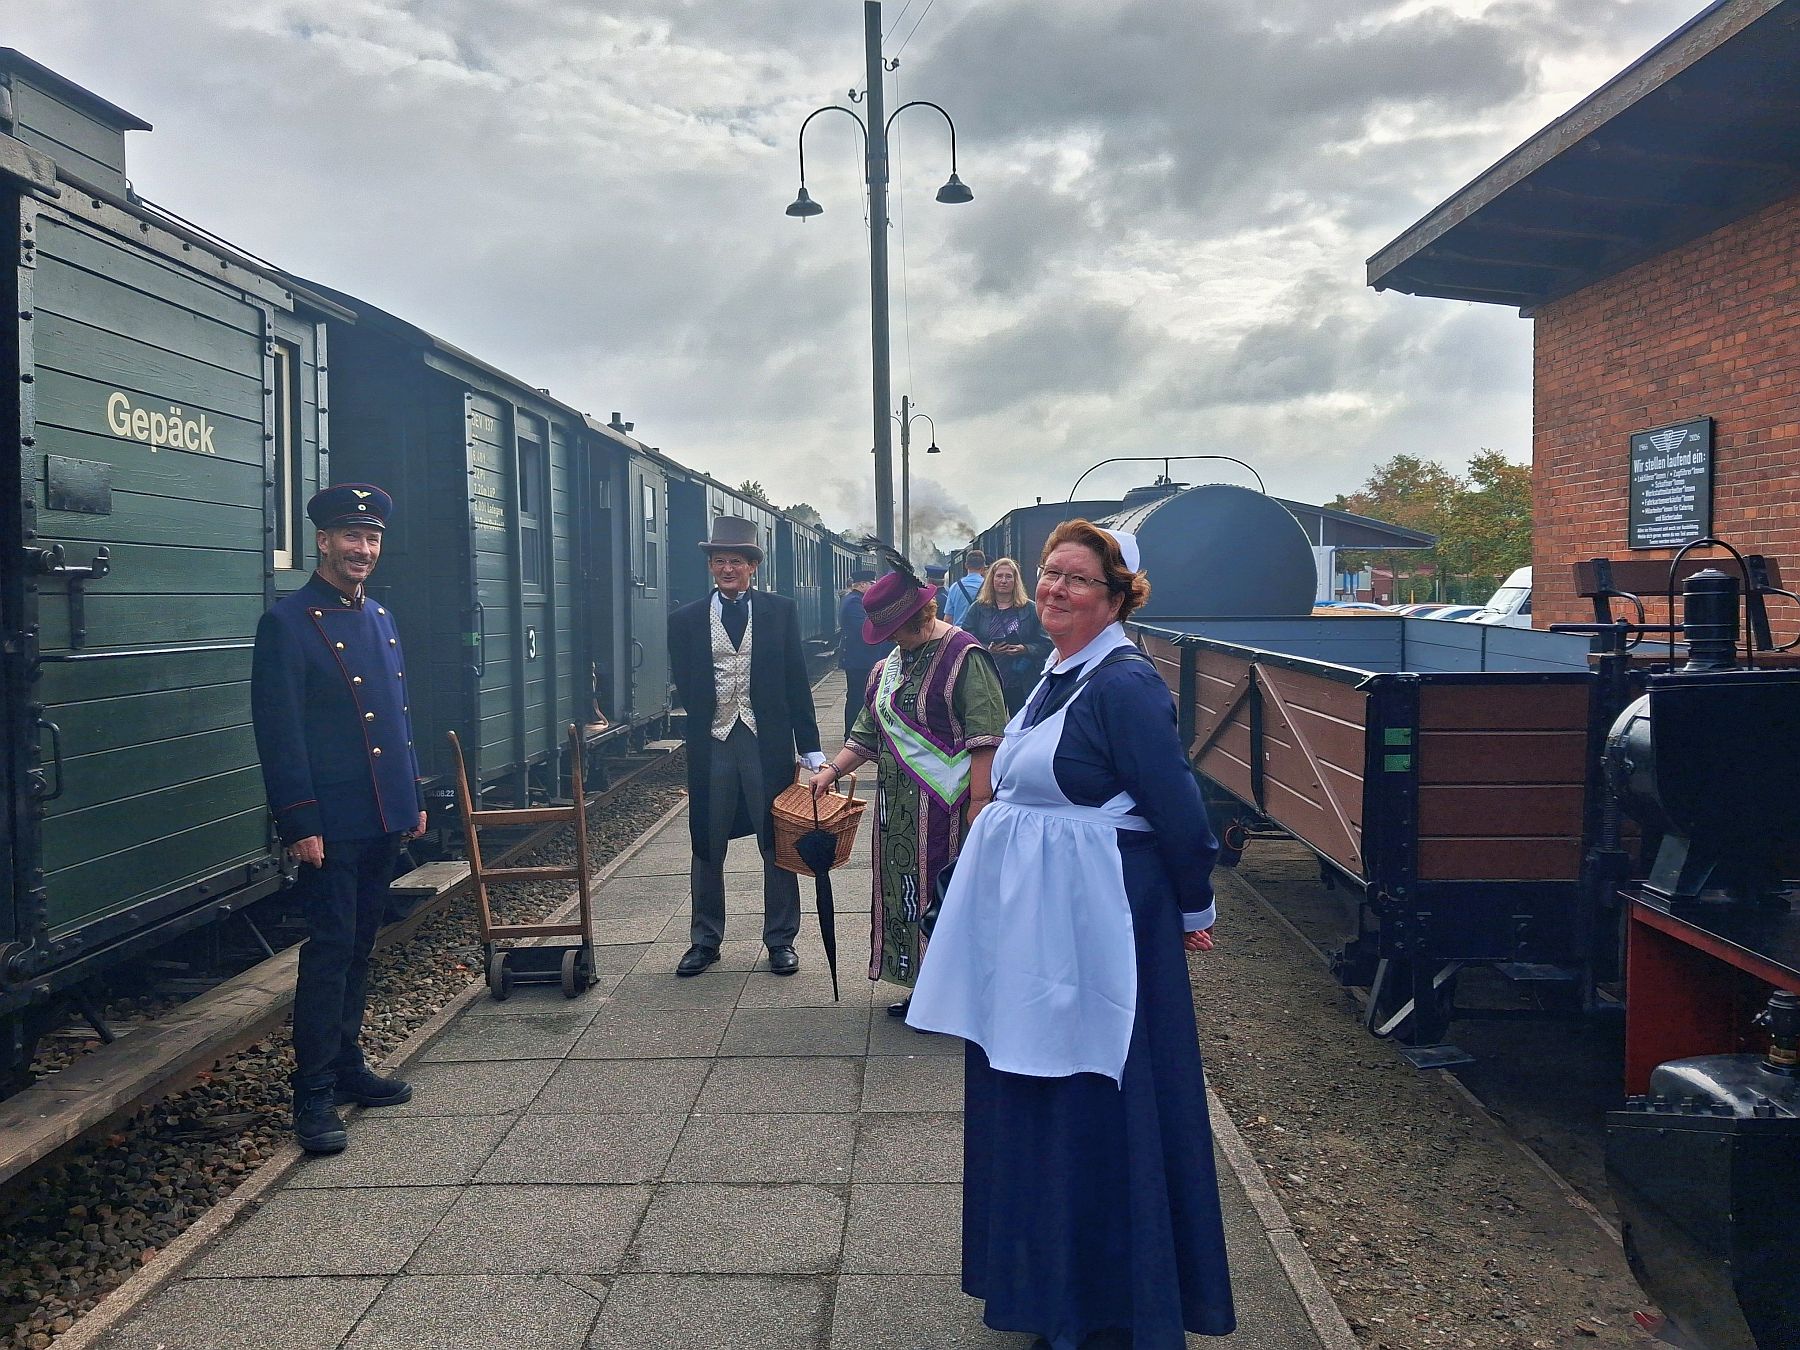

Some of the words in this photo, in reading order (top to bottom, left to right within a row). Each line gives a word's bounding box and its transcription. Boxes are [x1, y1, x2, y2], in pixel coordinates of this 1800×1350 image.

[107, 391, 215, 454] Gepäck
[1633, 459, 1645, 473] Wir
[1645, 456, 1666, 471] stellen
[1666, 451, 1691, 468] laufend
[1692, 449, 1706, 464] ein:
[529, 629, 536, 659] 3
[885, 656, 900, 685] VOTES
